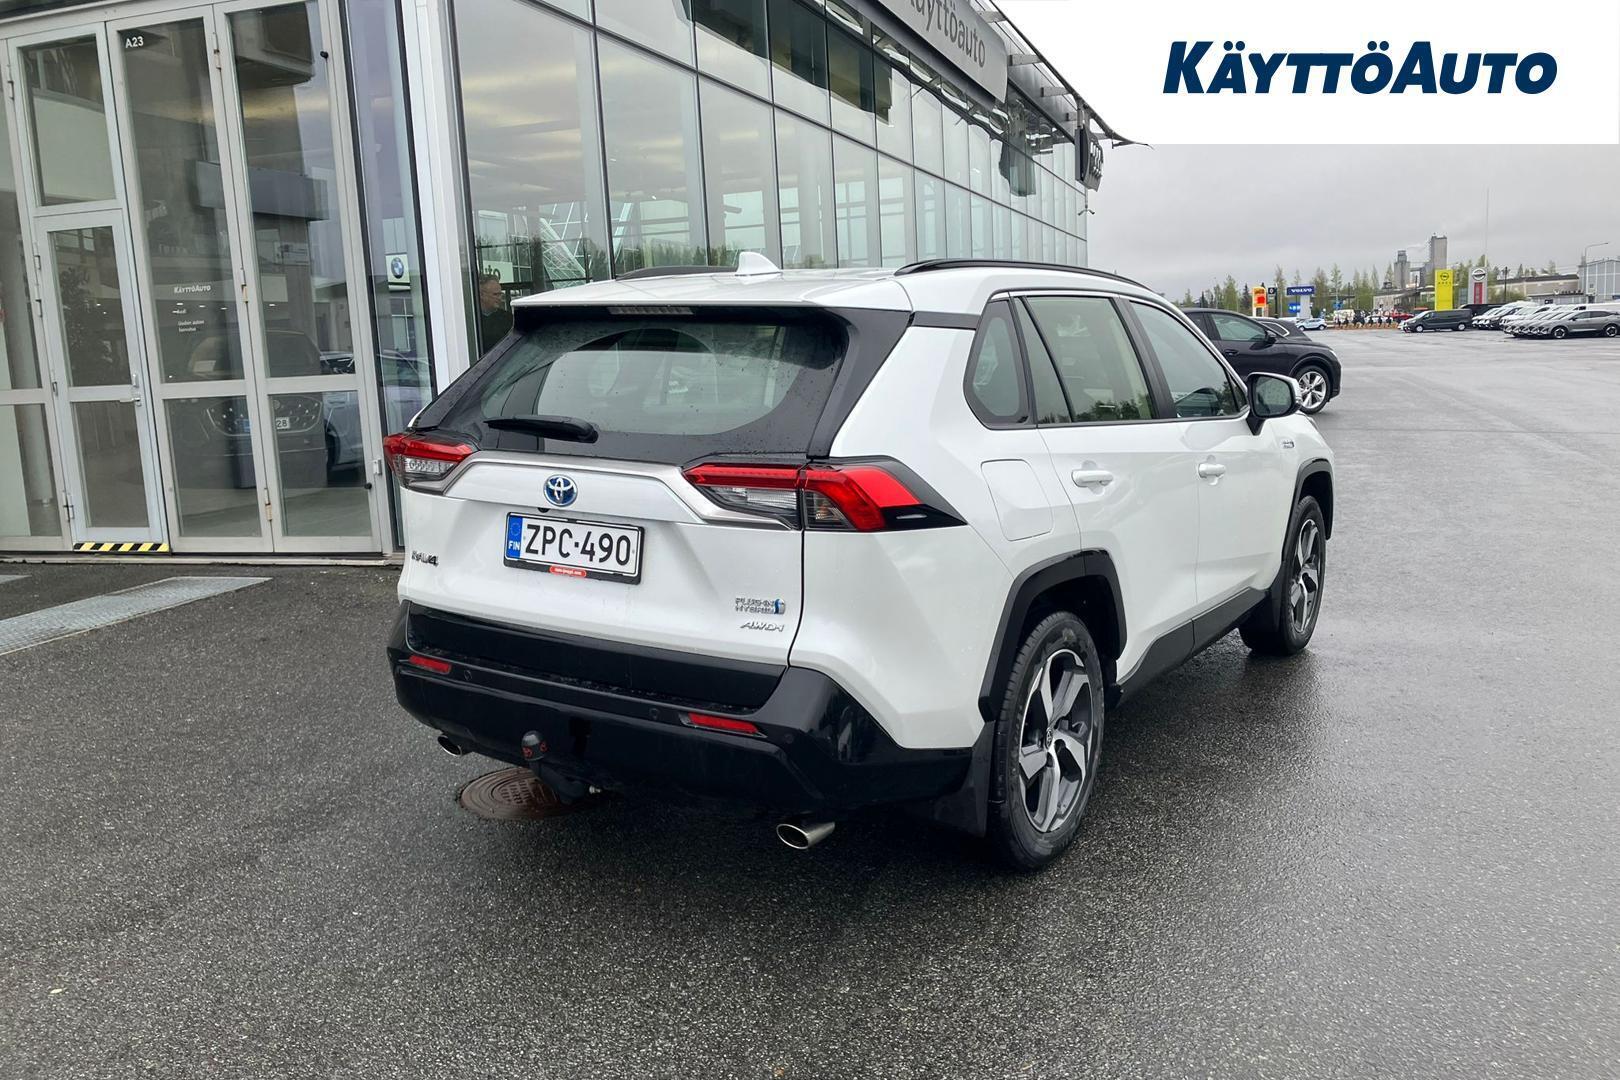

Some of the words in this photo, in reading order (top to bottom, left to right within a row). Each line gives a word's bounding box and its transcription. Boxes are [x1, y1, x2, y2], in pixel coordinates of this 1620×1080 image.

[125, 36, 144, 48] A23
[508, 540, 521, 551] FIN
[525, 523, 632, 566] ZPC-490
